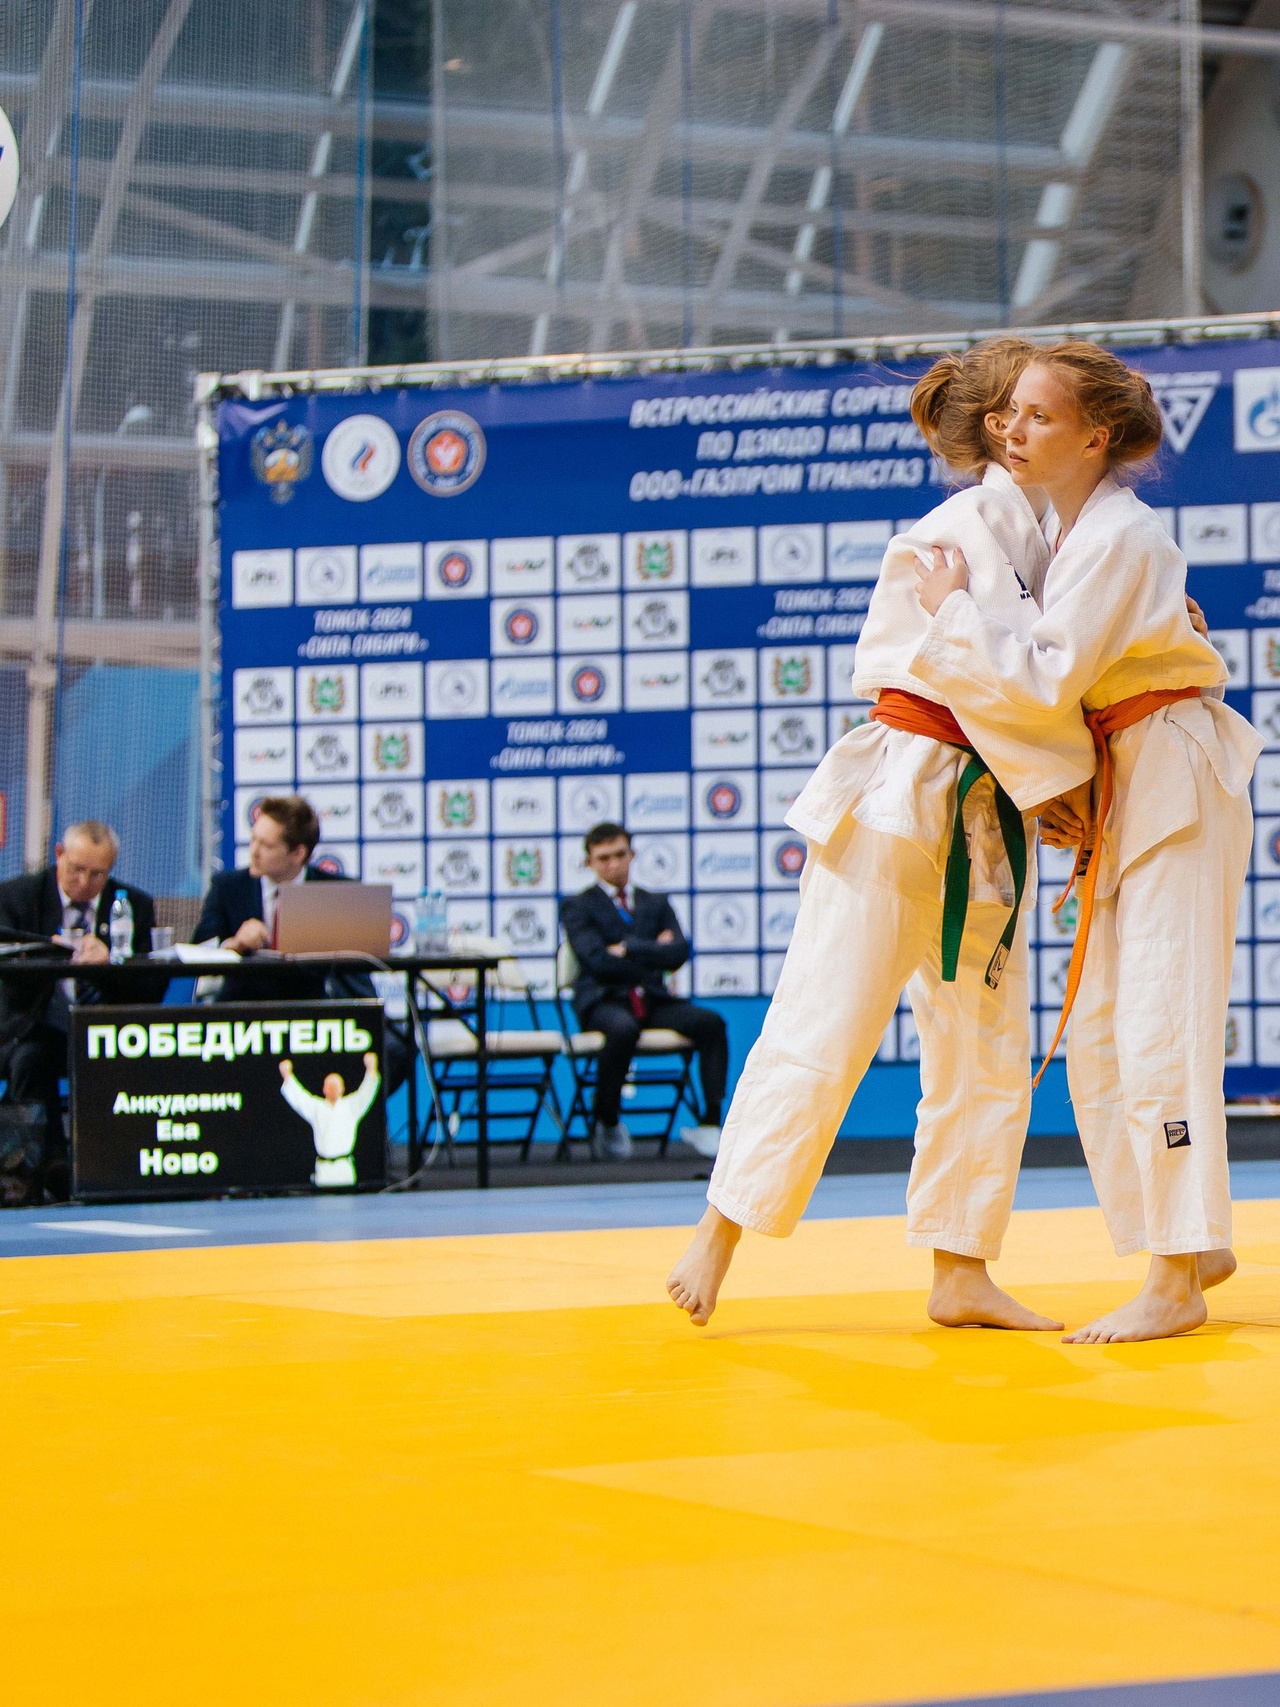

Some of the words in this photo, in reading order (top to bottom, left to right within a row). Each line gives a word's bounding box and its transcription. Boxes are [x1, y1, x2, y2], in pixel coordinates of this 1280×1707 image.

[630, 387, 831, 429] ВСЕРОССИЙСКИЕ
[832, 384, 913, 417] СОРЕВ
[696, 429, 735, 461] ПО
[733, 425, 826, 462] ДЗЮДО
[827, 423, 863, 454] НА
[808, 457, 925, 492] ТРАНСГАЗ
[87, 1018, 373, 1061] ПОБЕДИТЕЛЬ
[113, 1091, 243, 1117] Анкудович
[156, 1119, 200, 1142] Ева
[139, 1148, 219, 1176] Ново
